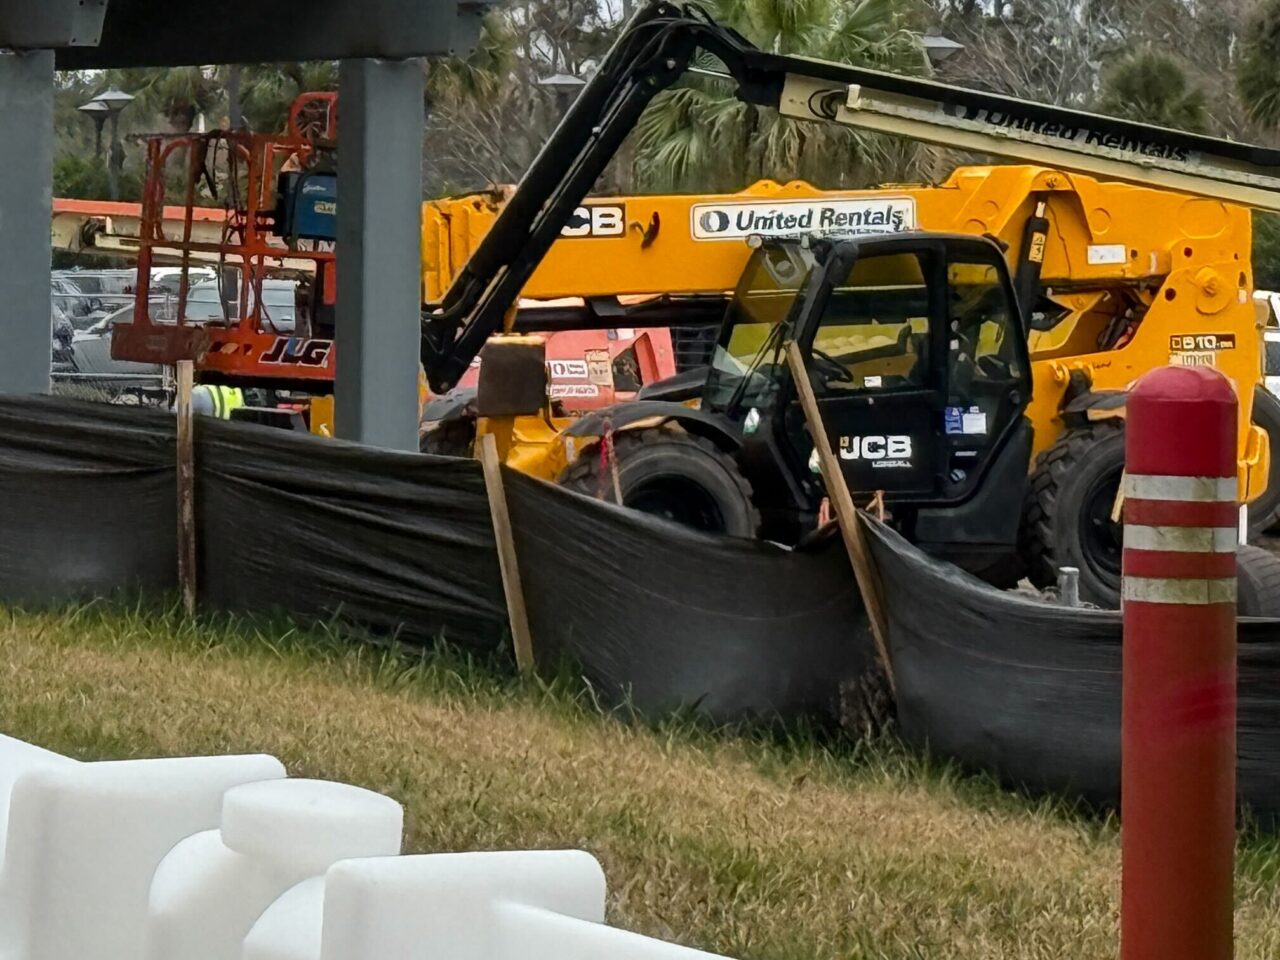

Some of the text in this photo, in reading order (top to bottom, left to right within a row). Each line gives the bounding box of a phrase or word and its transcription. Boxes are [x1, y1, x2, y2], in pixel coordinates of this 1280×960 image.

[560, 207, 624, 236] CB
[736, 204, 904, 231] United Rentals
[258, 336, 334, 367] JLG
[839, 435, 912, 459] JCB
